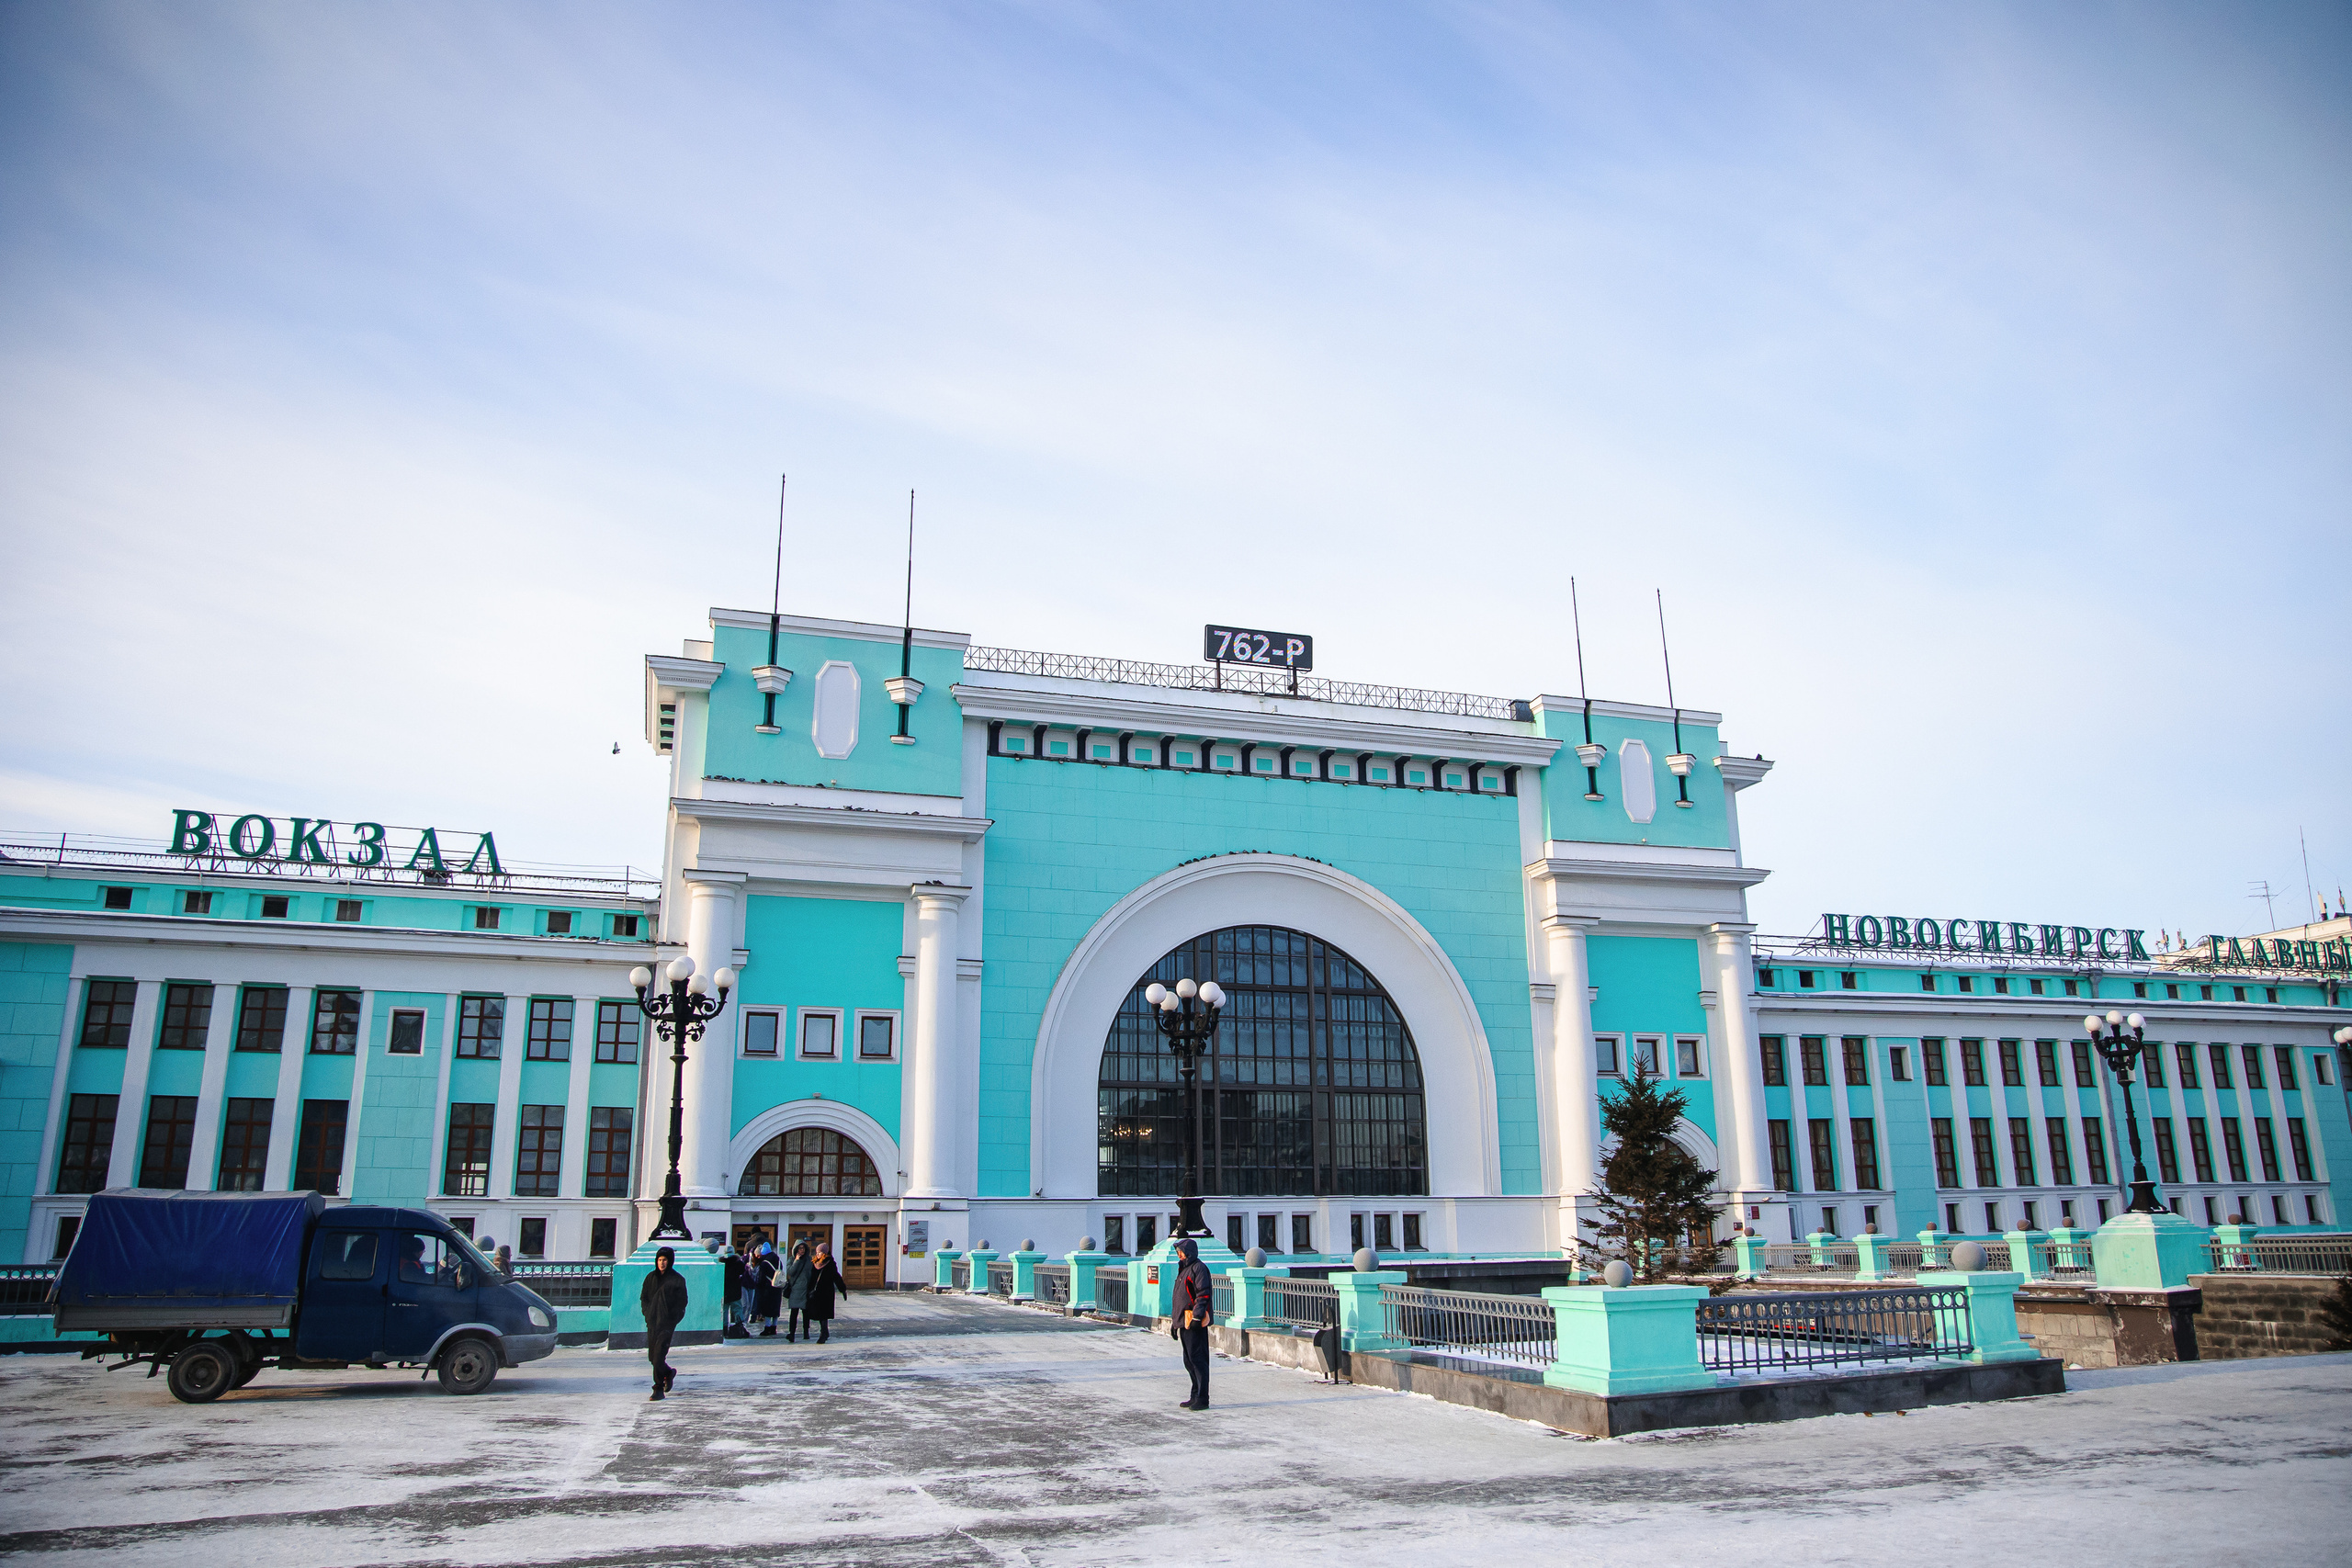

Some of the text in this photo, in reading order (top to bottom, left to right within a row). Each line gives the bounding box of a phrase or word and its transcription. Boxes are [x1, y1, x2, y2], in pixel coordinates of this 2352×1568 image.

[1214, 630, 1305, 665] 762-P
[165, 808, 506, 874] ВОКЗАЛ
[1822, 913, 2151, 961] НОВОСИБИРСК
